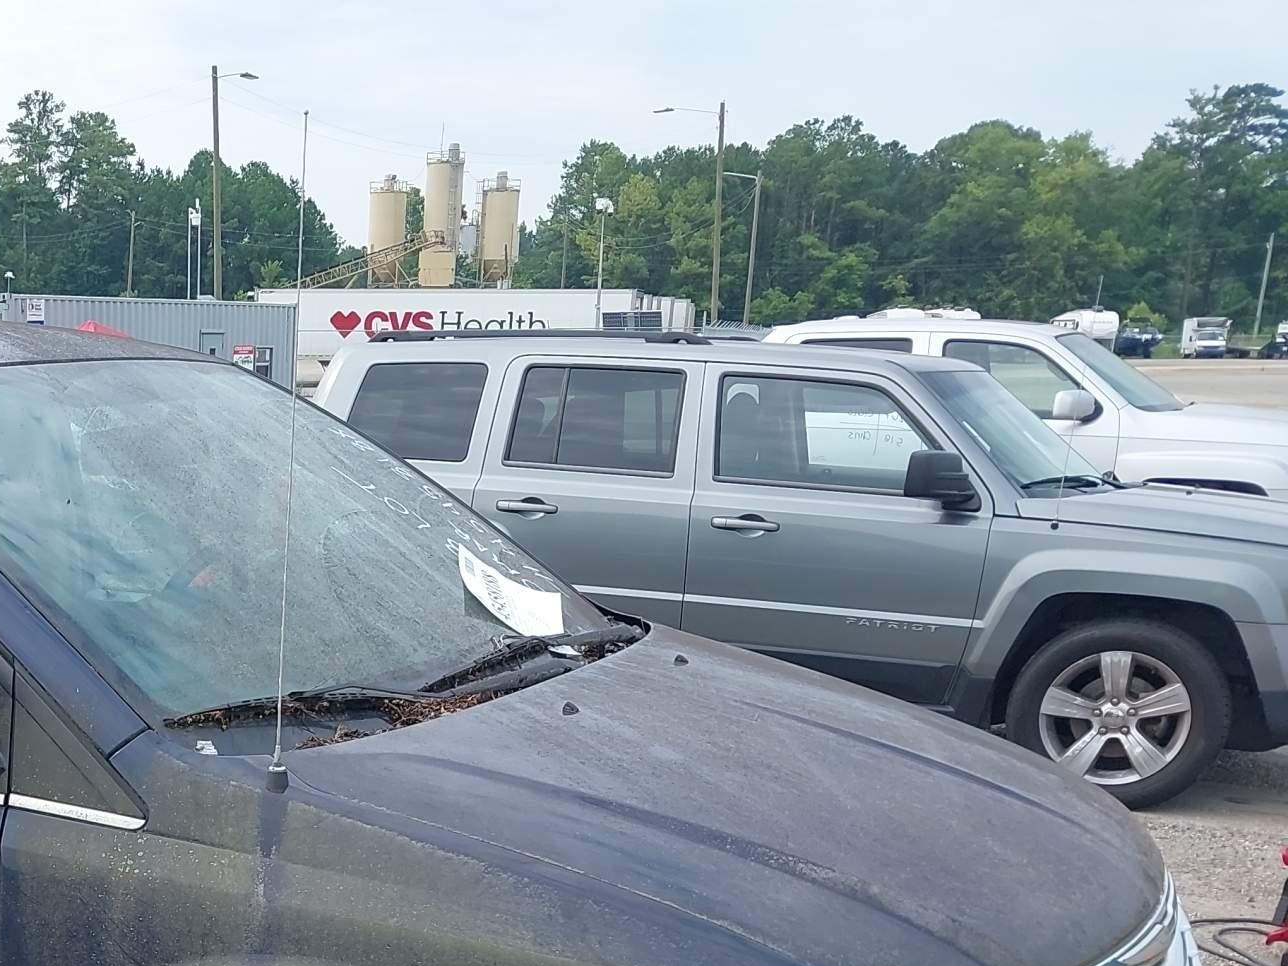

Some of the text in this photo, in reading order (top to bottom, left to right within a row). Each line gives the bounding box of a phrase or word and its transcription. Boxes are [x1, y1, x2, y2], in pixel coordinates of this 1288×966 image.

[364, 311, 546, 337] CVS Health
[845, 616, 943, 633] PATRIOT
